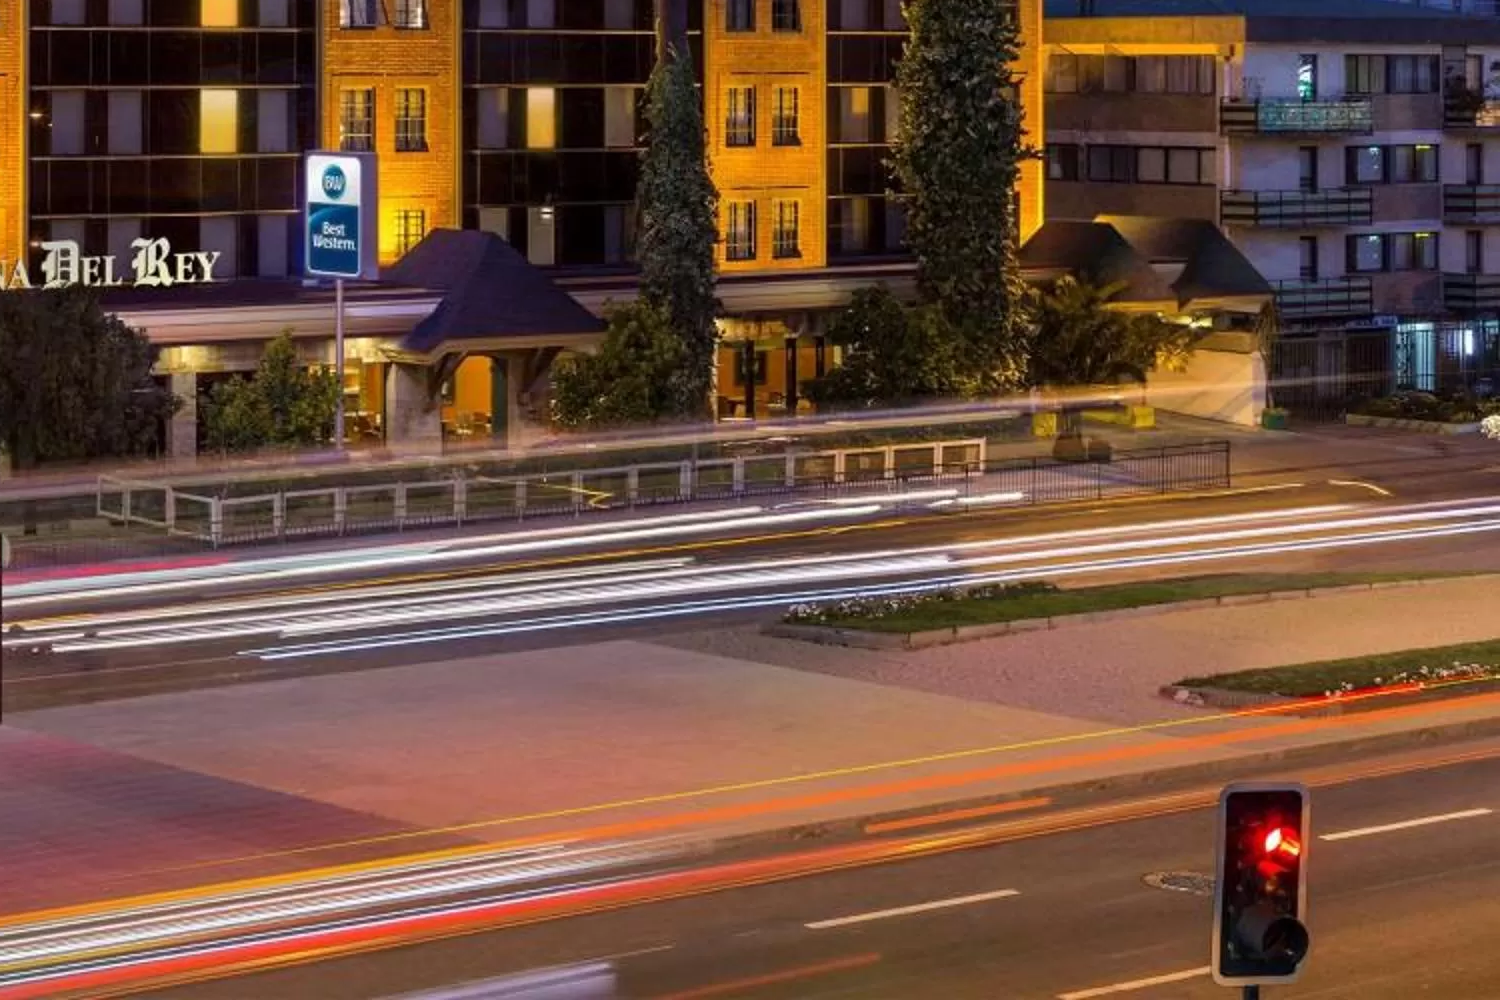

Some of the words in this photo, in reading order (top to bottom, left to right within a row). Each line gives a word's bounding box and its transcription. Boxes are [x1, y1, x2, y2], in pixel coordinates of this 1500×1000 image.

[323, 221, 346, 237] Best
[312, 233, 356, 251] Western
[40, 239, 123, 289] DEL
[130, 236, 221, 288] REY
